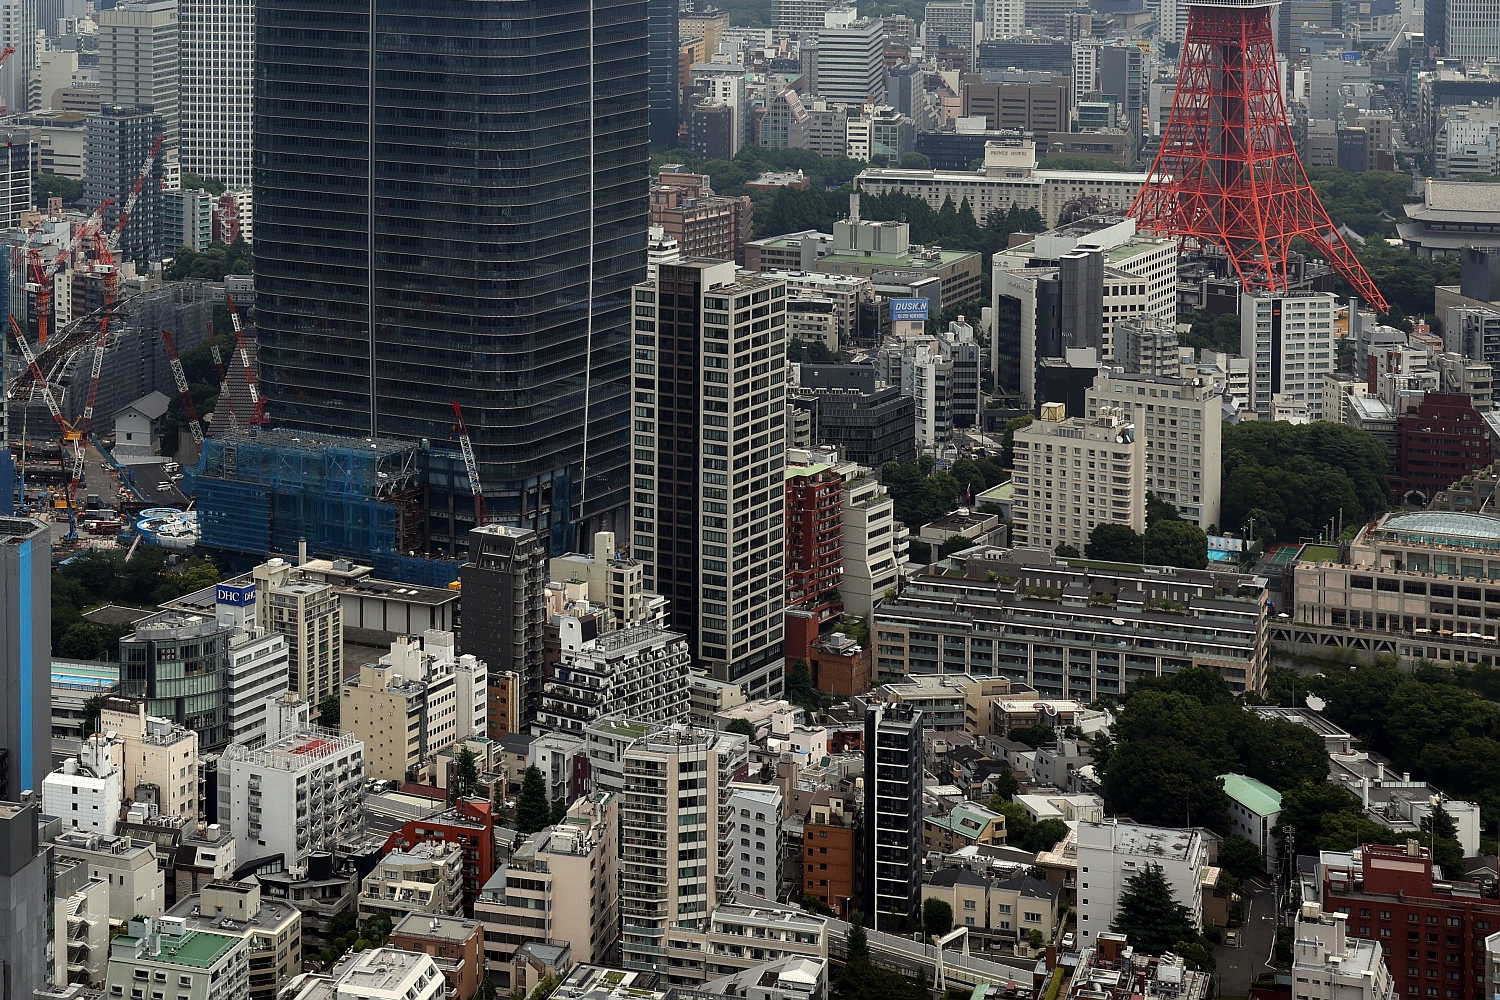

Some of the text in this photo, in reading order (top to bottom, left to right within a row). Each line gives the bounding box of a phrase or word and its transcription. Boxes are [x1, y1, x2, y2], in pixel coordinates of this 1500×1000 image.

[895, 302, 927, 311] DUSKIN
[217, 589, 240, 602] DHC
[244, 590, 256, 602] DHC
